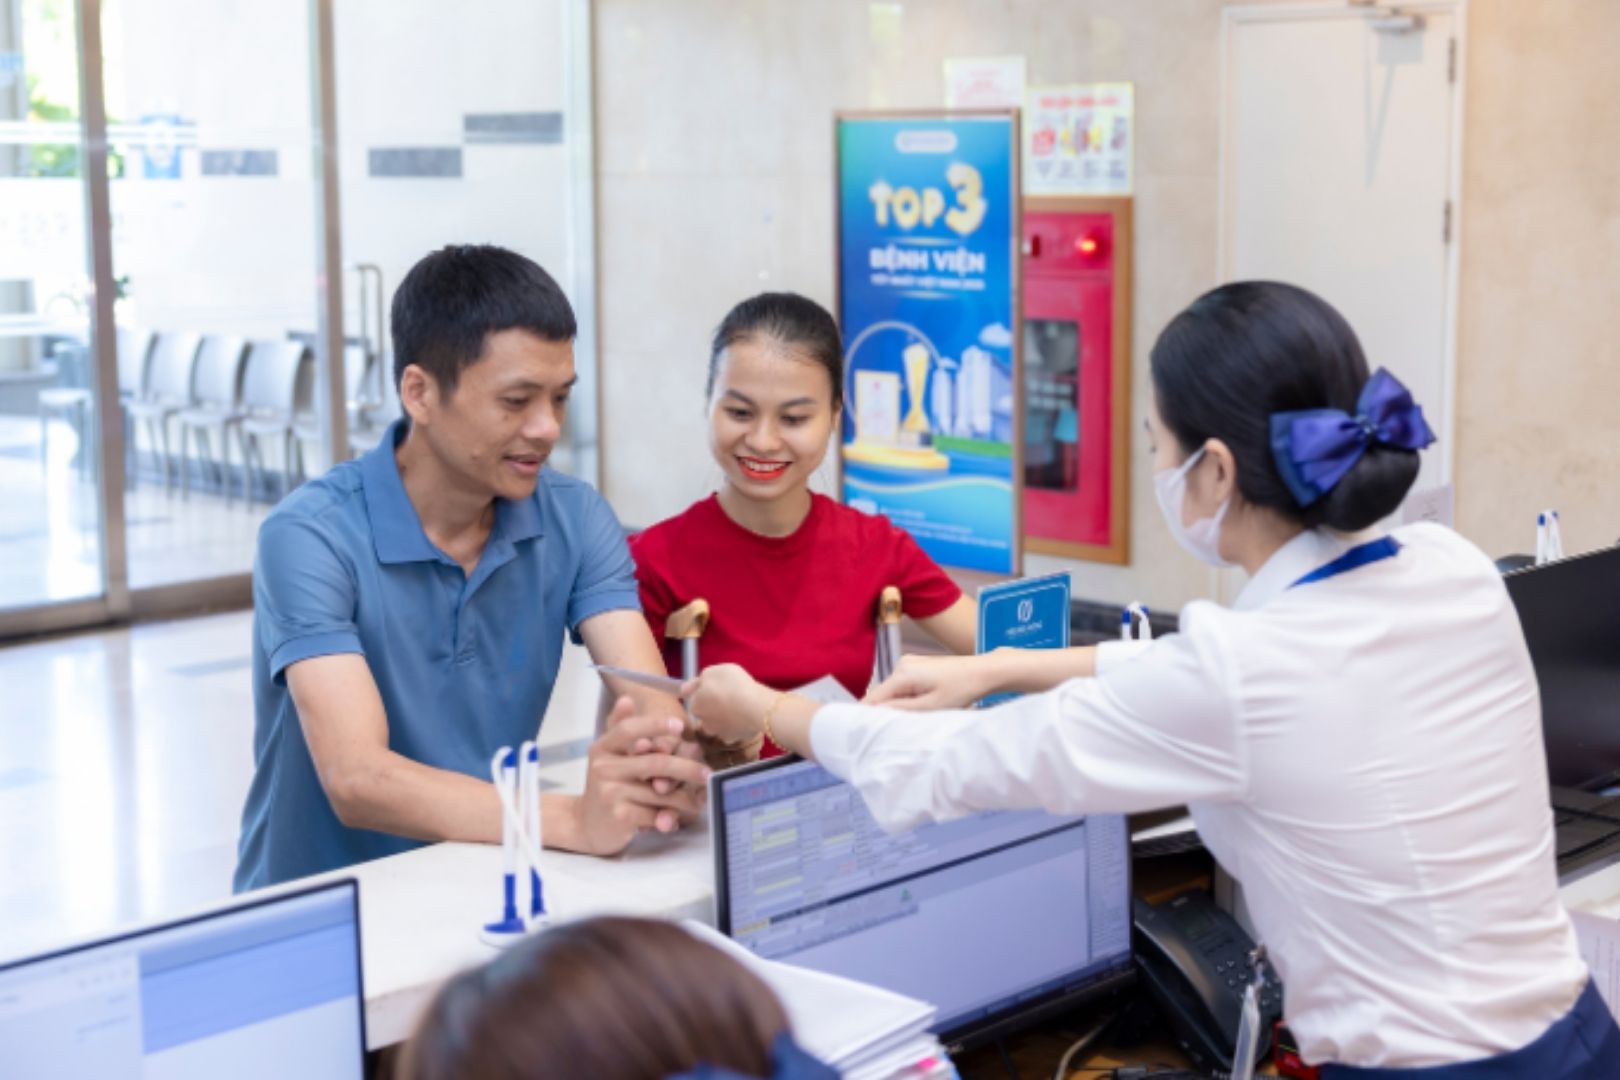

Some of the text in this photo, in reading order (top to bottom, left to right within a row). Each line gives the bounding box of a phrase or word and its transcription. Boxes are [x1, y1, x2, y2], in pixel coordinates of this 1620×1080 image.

[869, 162, 987, 234] TOP 3
[870, 244, 985, 276] BỆNH VIỆN
